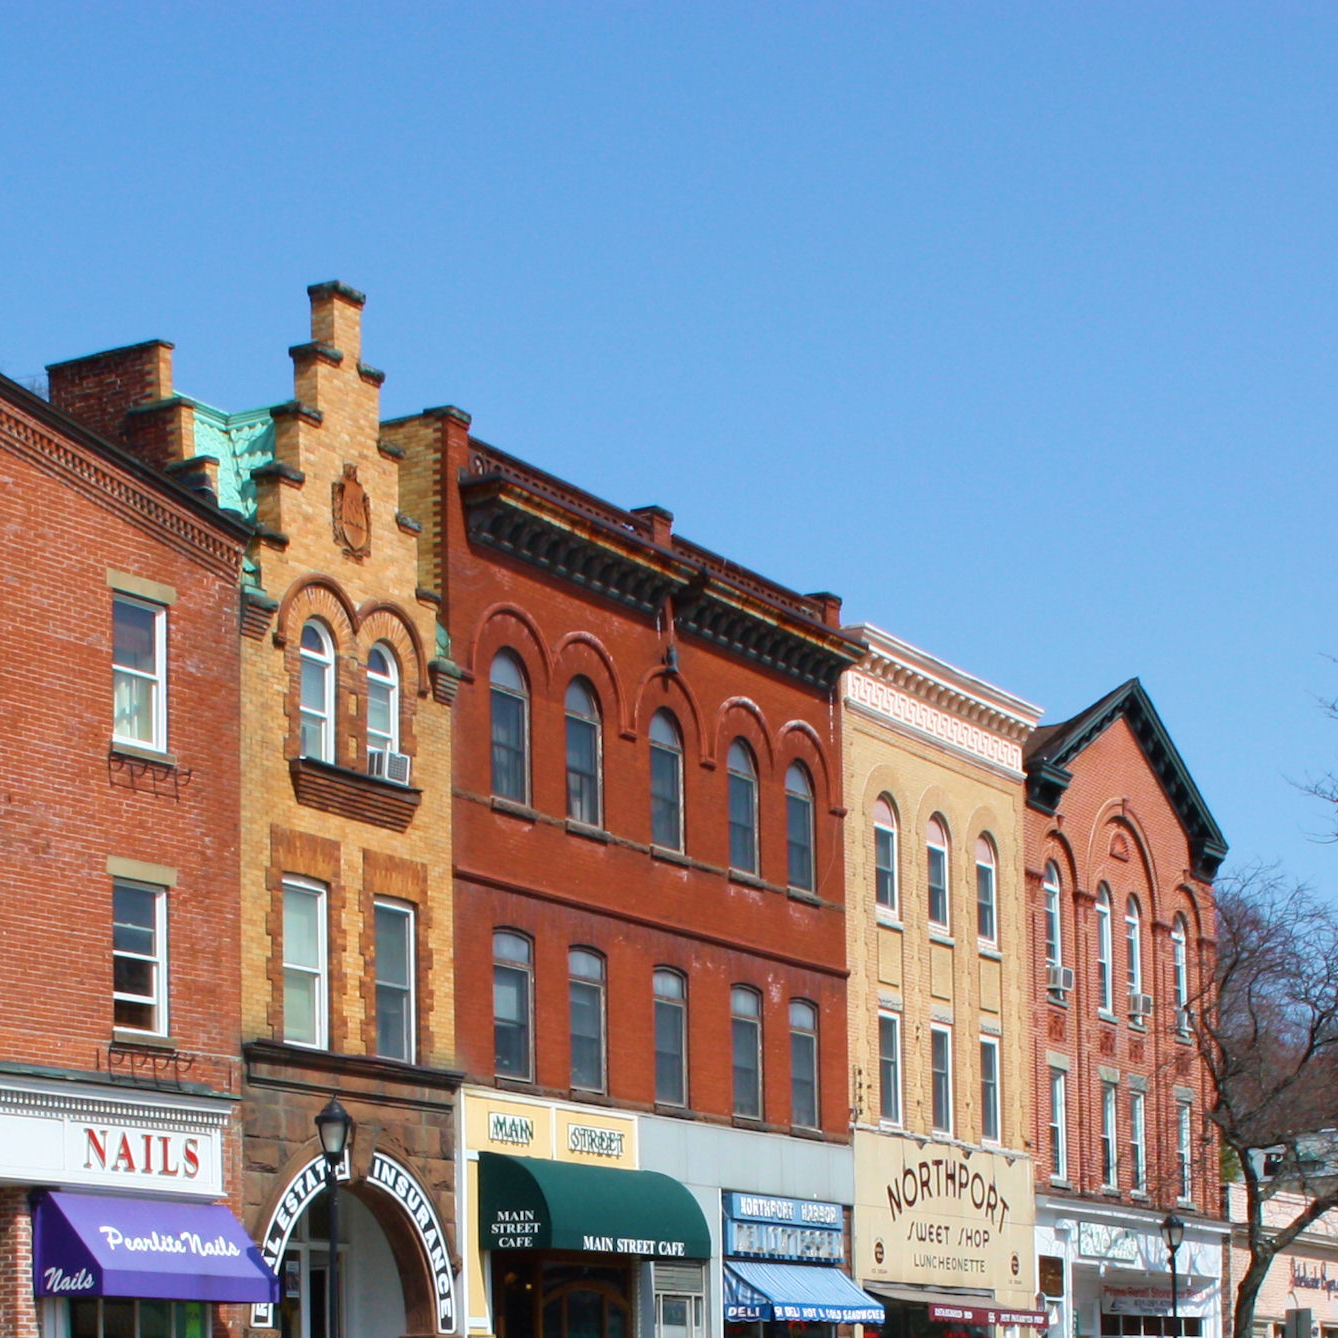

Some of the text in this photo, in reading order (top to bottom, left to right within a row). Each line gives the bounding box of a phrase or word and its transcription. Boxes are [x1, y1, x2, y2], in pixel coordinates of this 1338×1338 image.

[492, 1115, 625, 1155] MAIN STREET
[83, 1128, 200, 1179] NAILS
[887, 1159, 1009, 1234] NORTHPORT
[497, 1210, 534, 1222] MAIN
[741, 1197, 838, 1223] NORTHPORT HARBOR
[373, 1159, 452, 1318] INSURANCE
[491, 1222, 541, 1234] STREET
[907, 1221, 990, 1248] SWEET SHOP
[99, 1226, 241, 1257] Pearlite Nails
[498, 1236, 533, 1248] CAFE
[583, 1235, 685, 1257] MAIN STREET CAFE
[914, 1254, 986, 1273] LUNCHEONETTE
[44, 1267, 95, 1293] Nails
[728, 1306, 759, 1317] DELI
